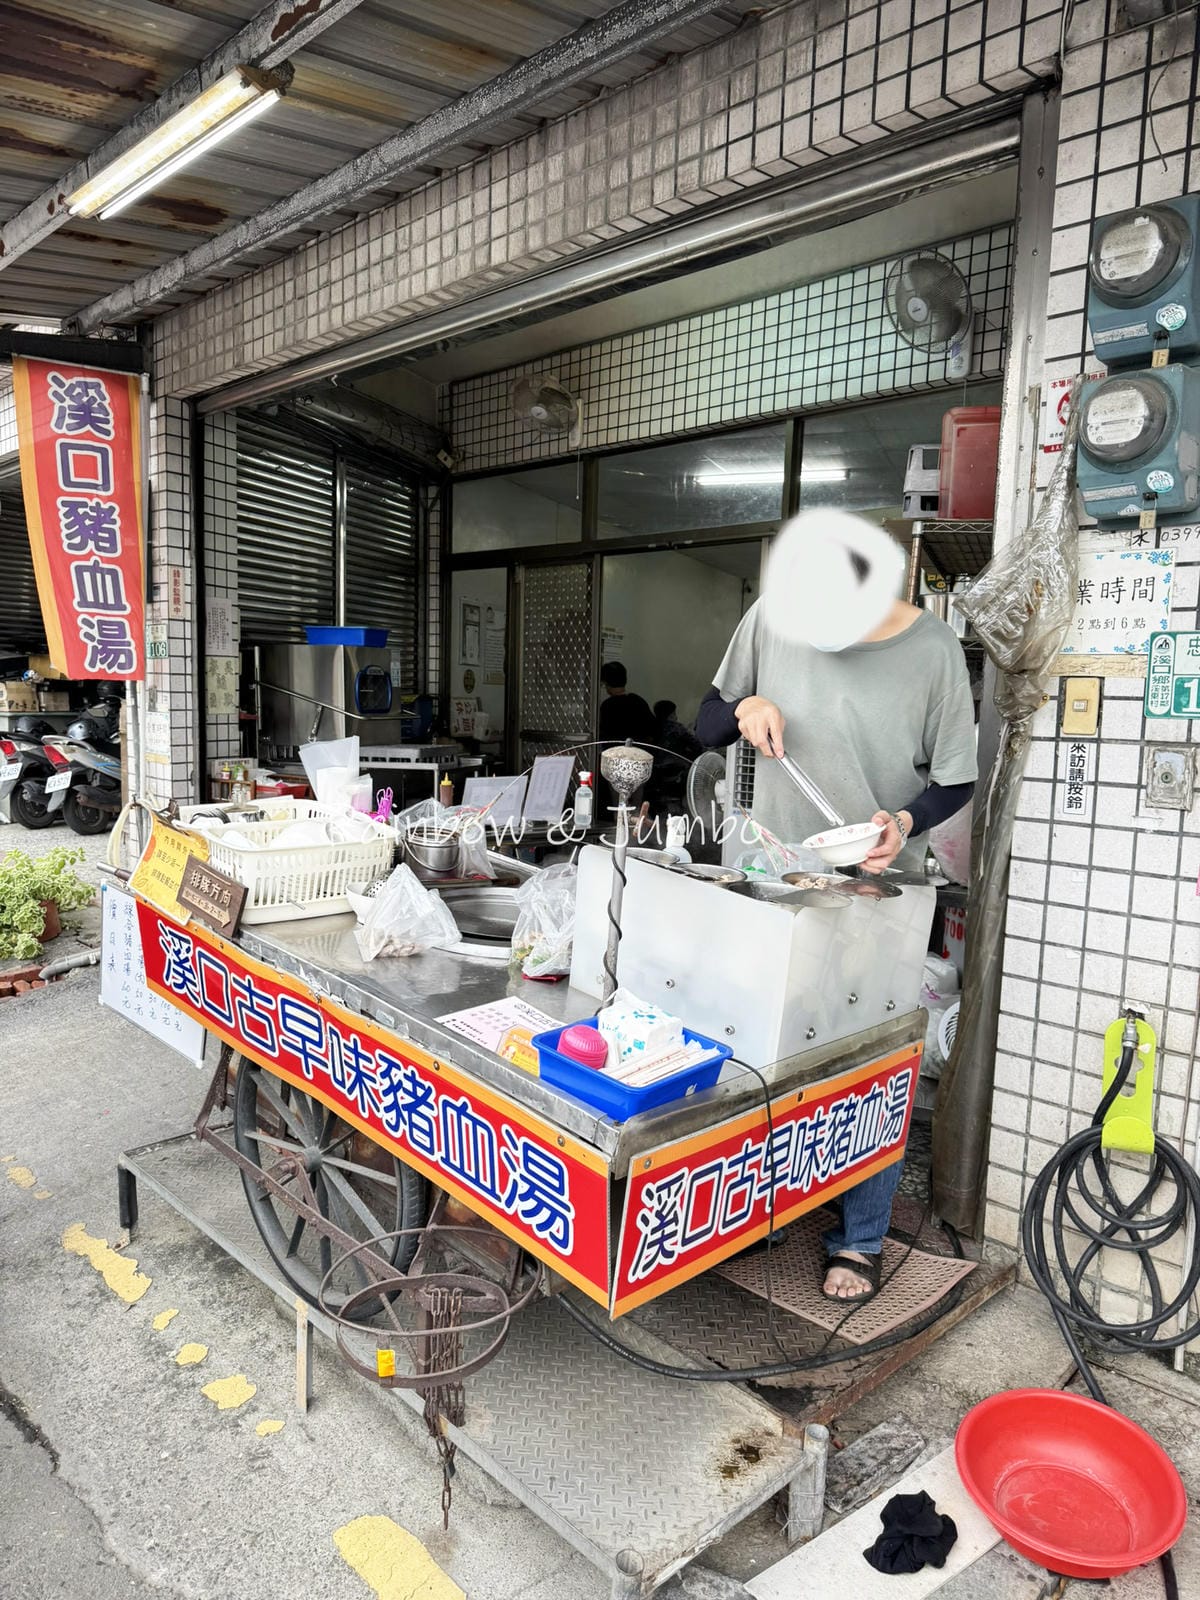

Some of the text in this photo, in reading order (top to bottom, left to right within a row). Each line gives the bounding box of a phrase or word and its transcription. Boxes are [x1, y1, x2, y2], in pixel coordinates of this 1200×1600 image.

[48, 371, 137, 674] 溪口豬血湯
[1132, 530, 1150, 546] 水
[150, 643, 167, 657] 106
[160, 920, 573, 1254] 溪口古早味豬血湯
[629, 1069, 911, 1281] 溪口古早味豬血湯
